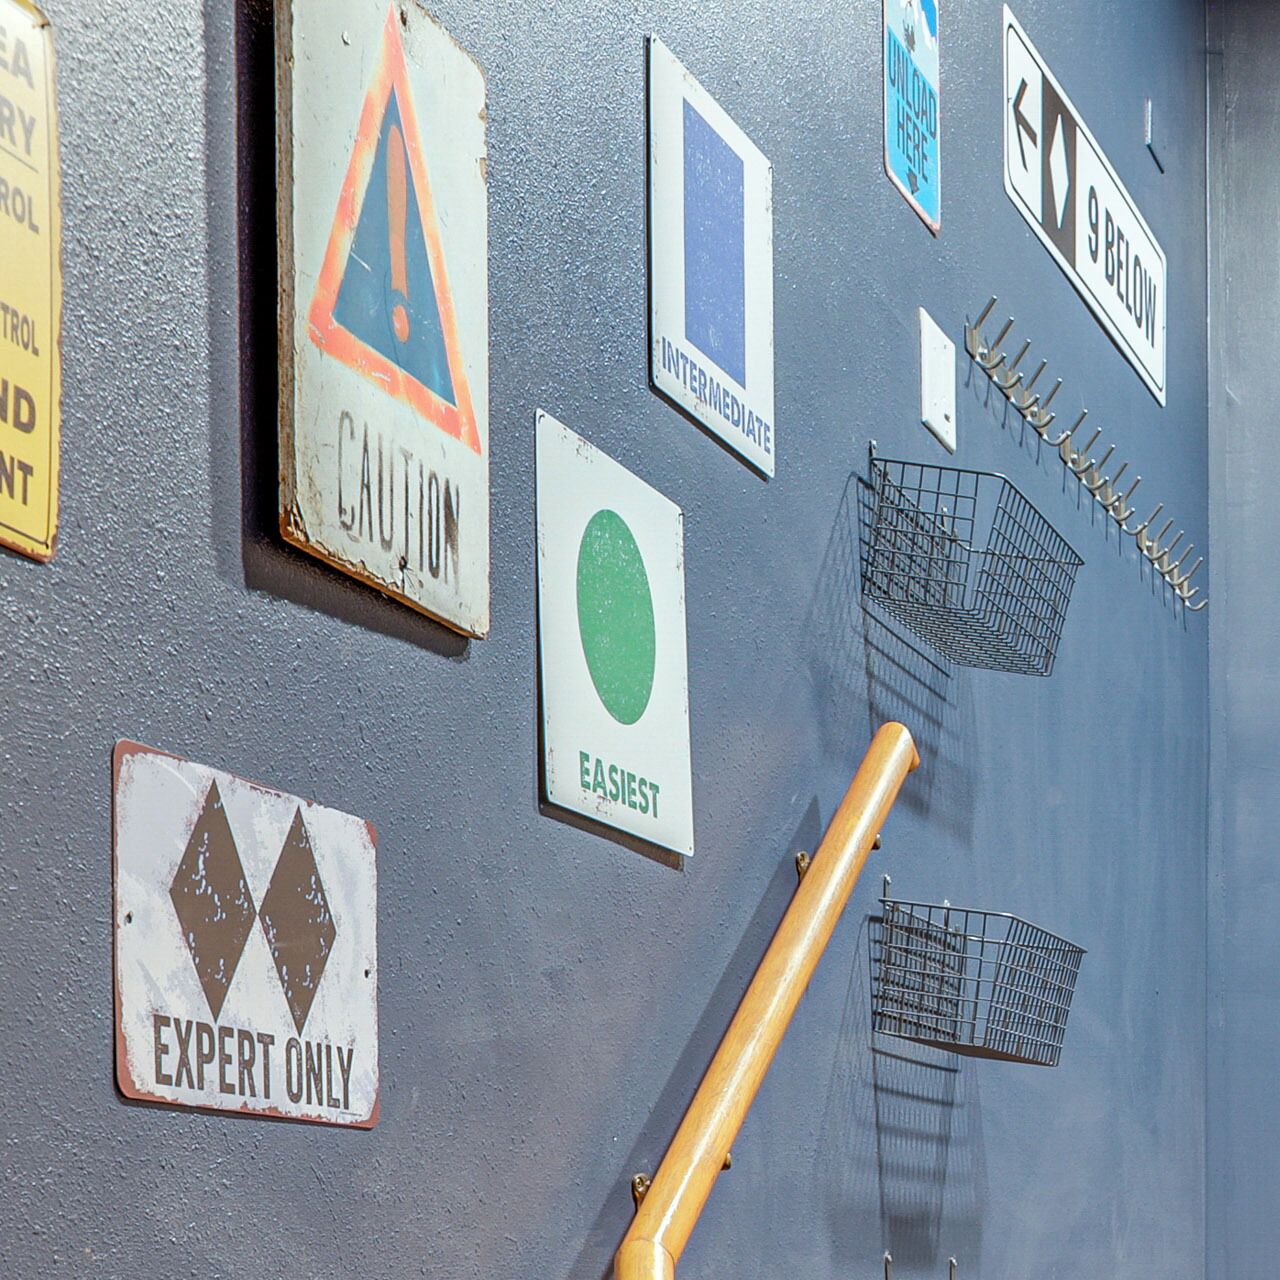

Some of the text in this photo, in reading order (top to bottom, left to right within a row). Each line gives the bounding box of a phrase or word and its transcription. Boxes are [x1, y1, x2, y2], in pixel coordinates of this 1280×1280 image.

[888, 32, 937, 140] UNLOAD
[896, 99, 929, 184] HERE
[1088, 185, 1157, 349] 9 BELOW
[660, 336, 771, 456] INTERMEDIATE
[337, 410, 462, 586] CAUTION
[579, 750, 660, 819] EASIEST
[153, 1014, 354, 1111] EXPERT ONLY
